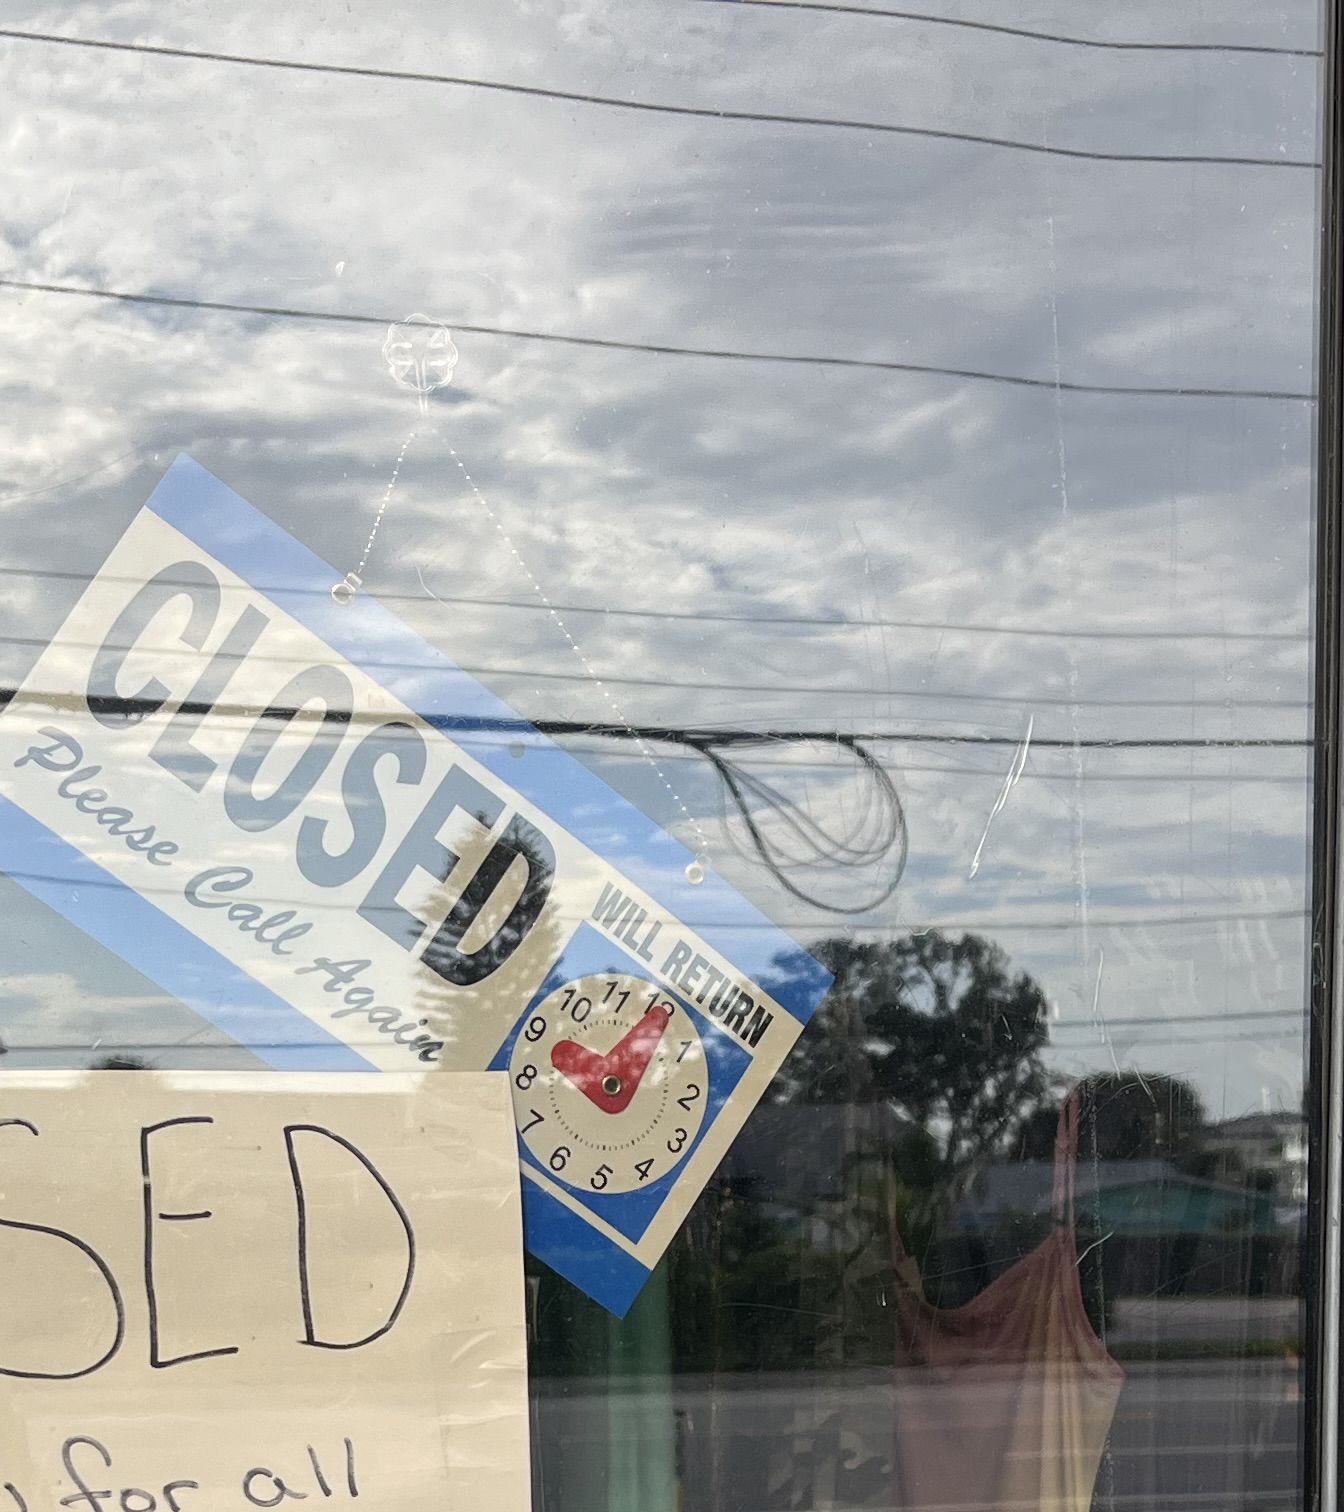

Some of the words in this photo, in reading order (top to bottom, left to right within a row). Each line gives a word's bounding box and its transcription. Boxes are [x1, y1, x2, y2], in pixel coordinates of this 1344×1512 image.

[86, 561, 557, 987] CLOSED
[15, 727, 180, 867] Please
[185, 866, 307, 957] Call
[296, 956, 444, 1064] Again
[591, 881, 662, 963] WILL
[659, 939, 775, 1048] RETURN
[559, 988, 592, 1022] 10
[601, 981, 631, 1013] 11
[524, 1016, 547, 1042] 9
[675, 1039, 693, 1064] 1
[515, 1064, 538, 1090] 8
[676, 1083, 701, 1111] 2
[521, 1109, 545, 1134] 7
[667, 1127, 688, 1153] 3
[549, 1146, 571, 1172] 6
[634, 1158, 654, 1181] 4
[590, 1164, 613, 1190] 5
[244, 1440, 356, 1504] all
